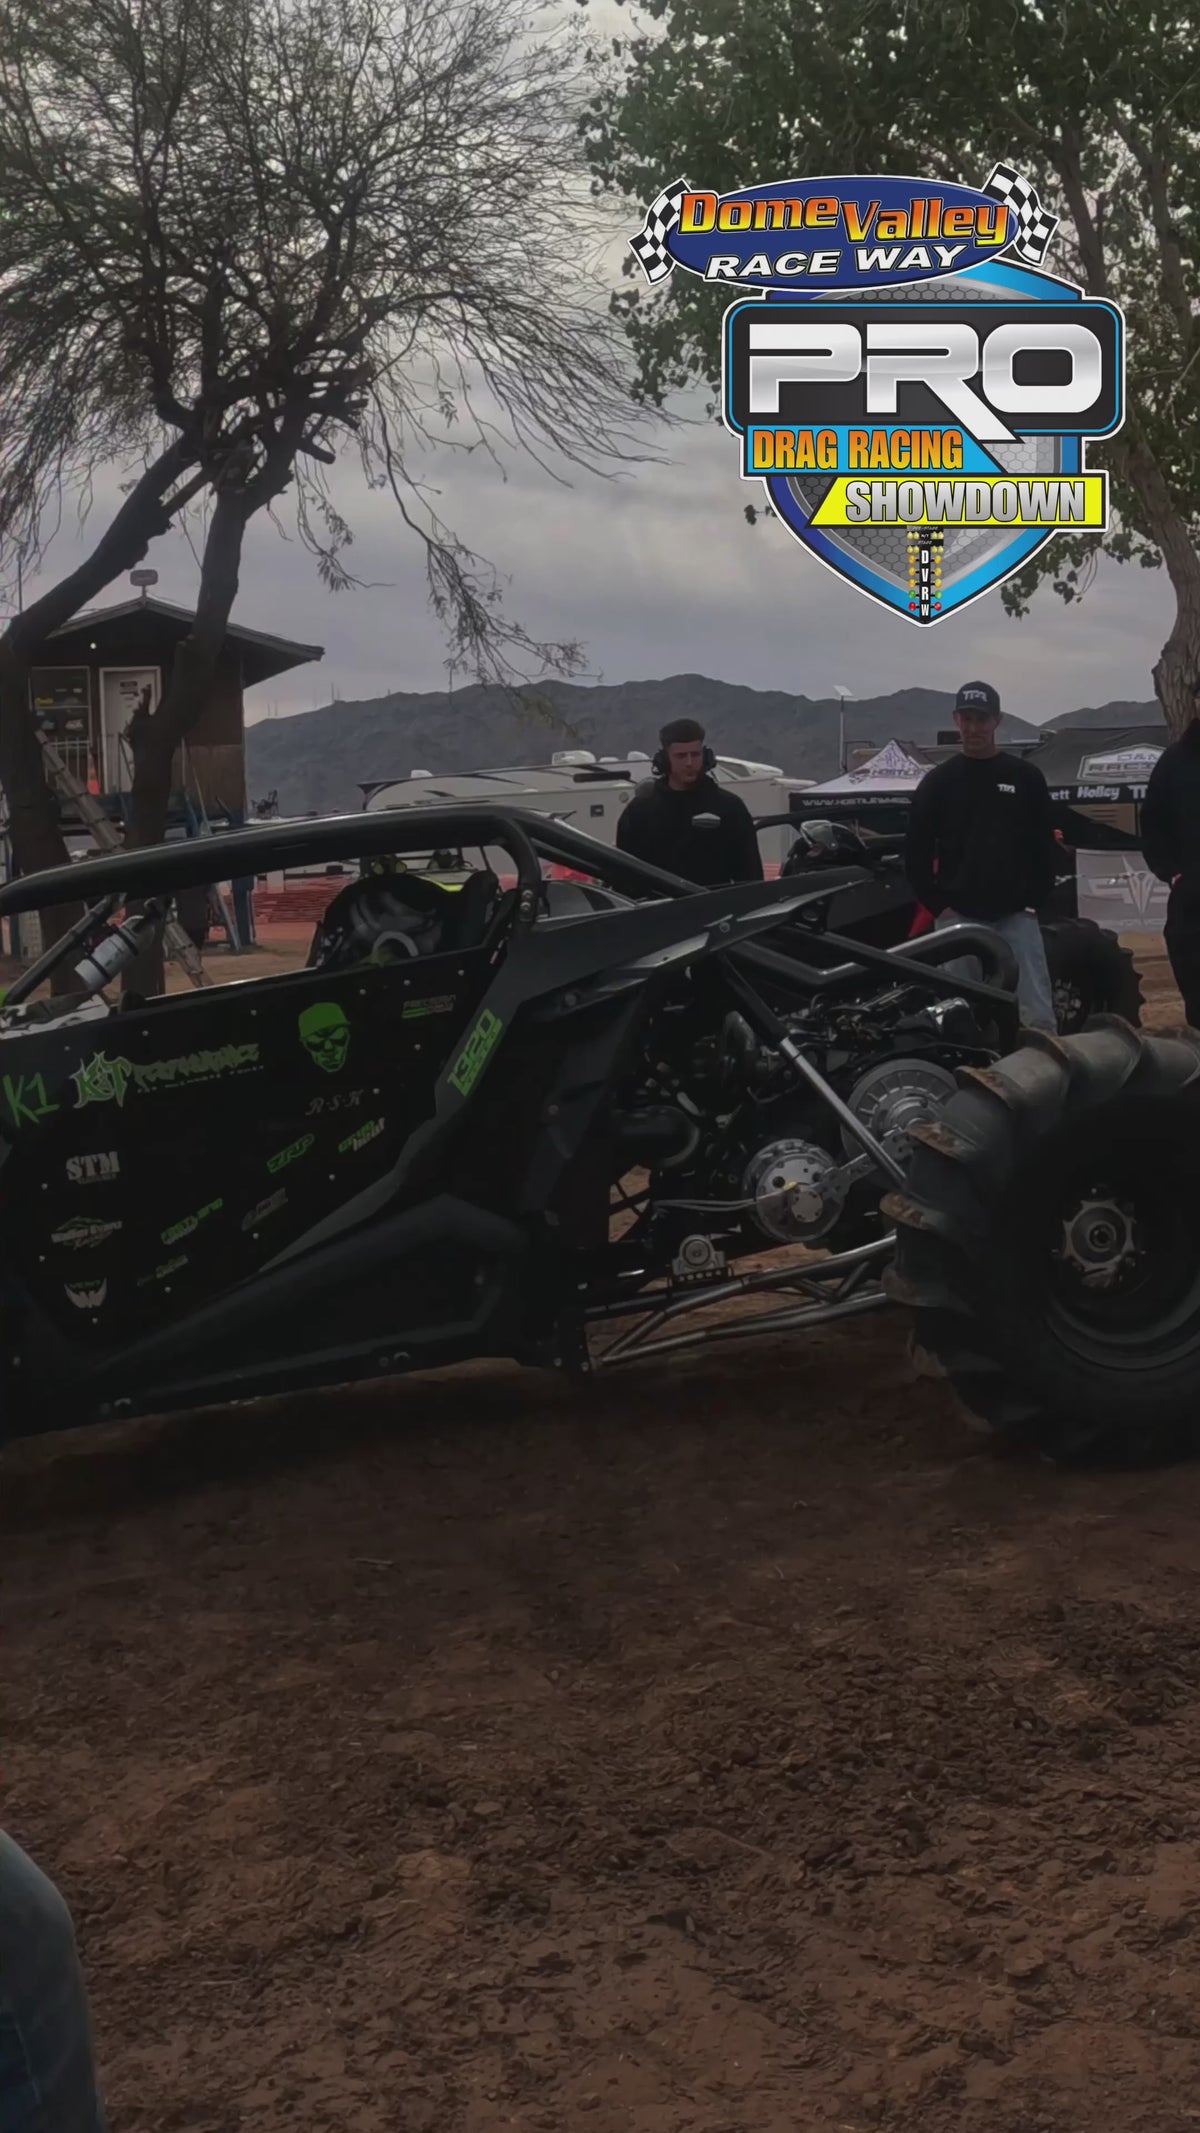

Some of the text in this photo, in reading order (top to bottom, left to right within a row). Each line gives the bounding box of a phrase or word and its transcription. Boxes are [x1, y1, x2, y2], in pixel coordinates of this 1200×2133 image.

[1049, 789, 1071, 801] ett
[1077, 785, 1121, 801] Holley
[447, 1008, 498, 1096] 1320
[2, 1072, 61, 1128] K1
[65, 1151, 121, 1181] STM
